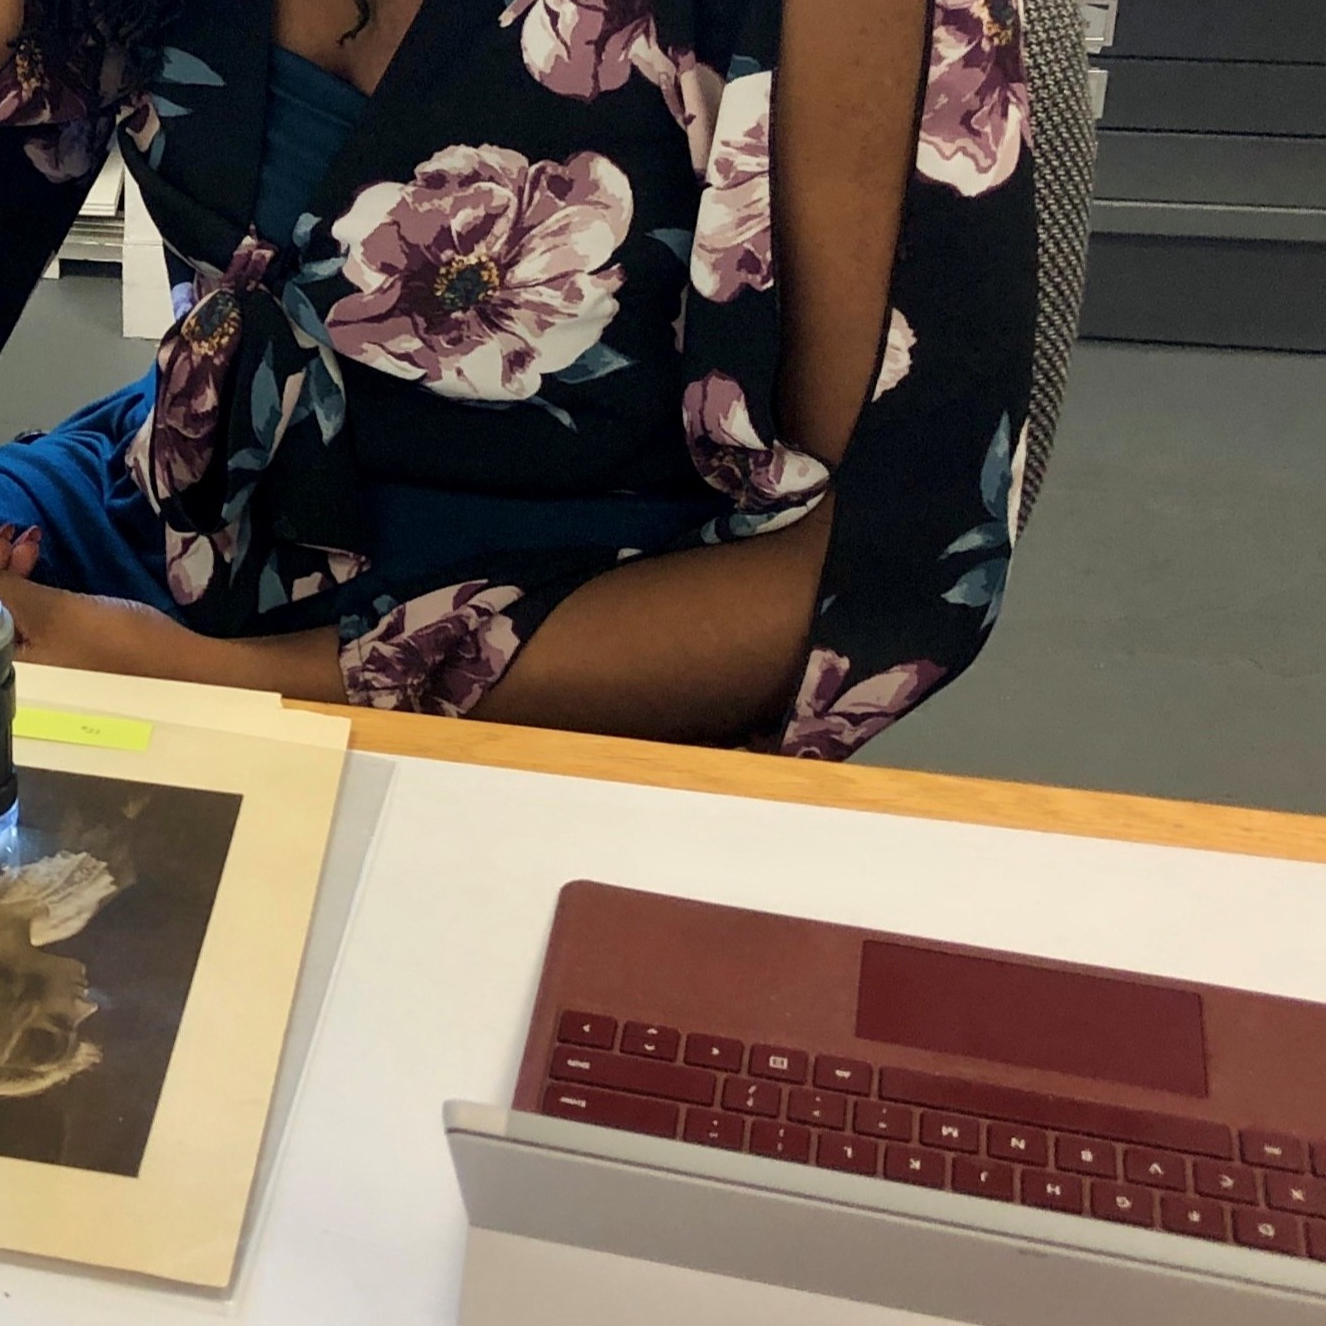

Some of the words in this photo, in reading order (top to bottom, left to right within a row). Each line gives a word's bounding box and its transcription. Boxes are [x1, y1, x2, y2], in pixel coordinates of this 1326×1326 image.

[941, 1125, 959, 1138] M
[1010, 1136, 1025, 1149] N
[842, 1146, 854, 1159] L
[908, 1158, 921, 1170] K
[1148, 1162, 1164, 1175] V
[980, 1170, 989, 1182] J
[1046, 1183, 1062, 1196] H
[1290, 1188, 1305, 1202] X
